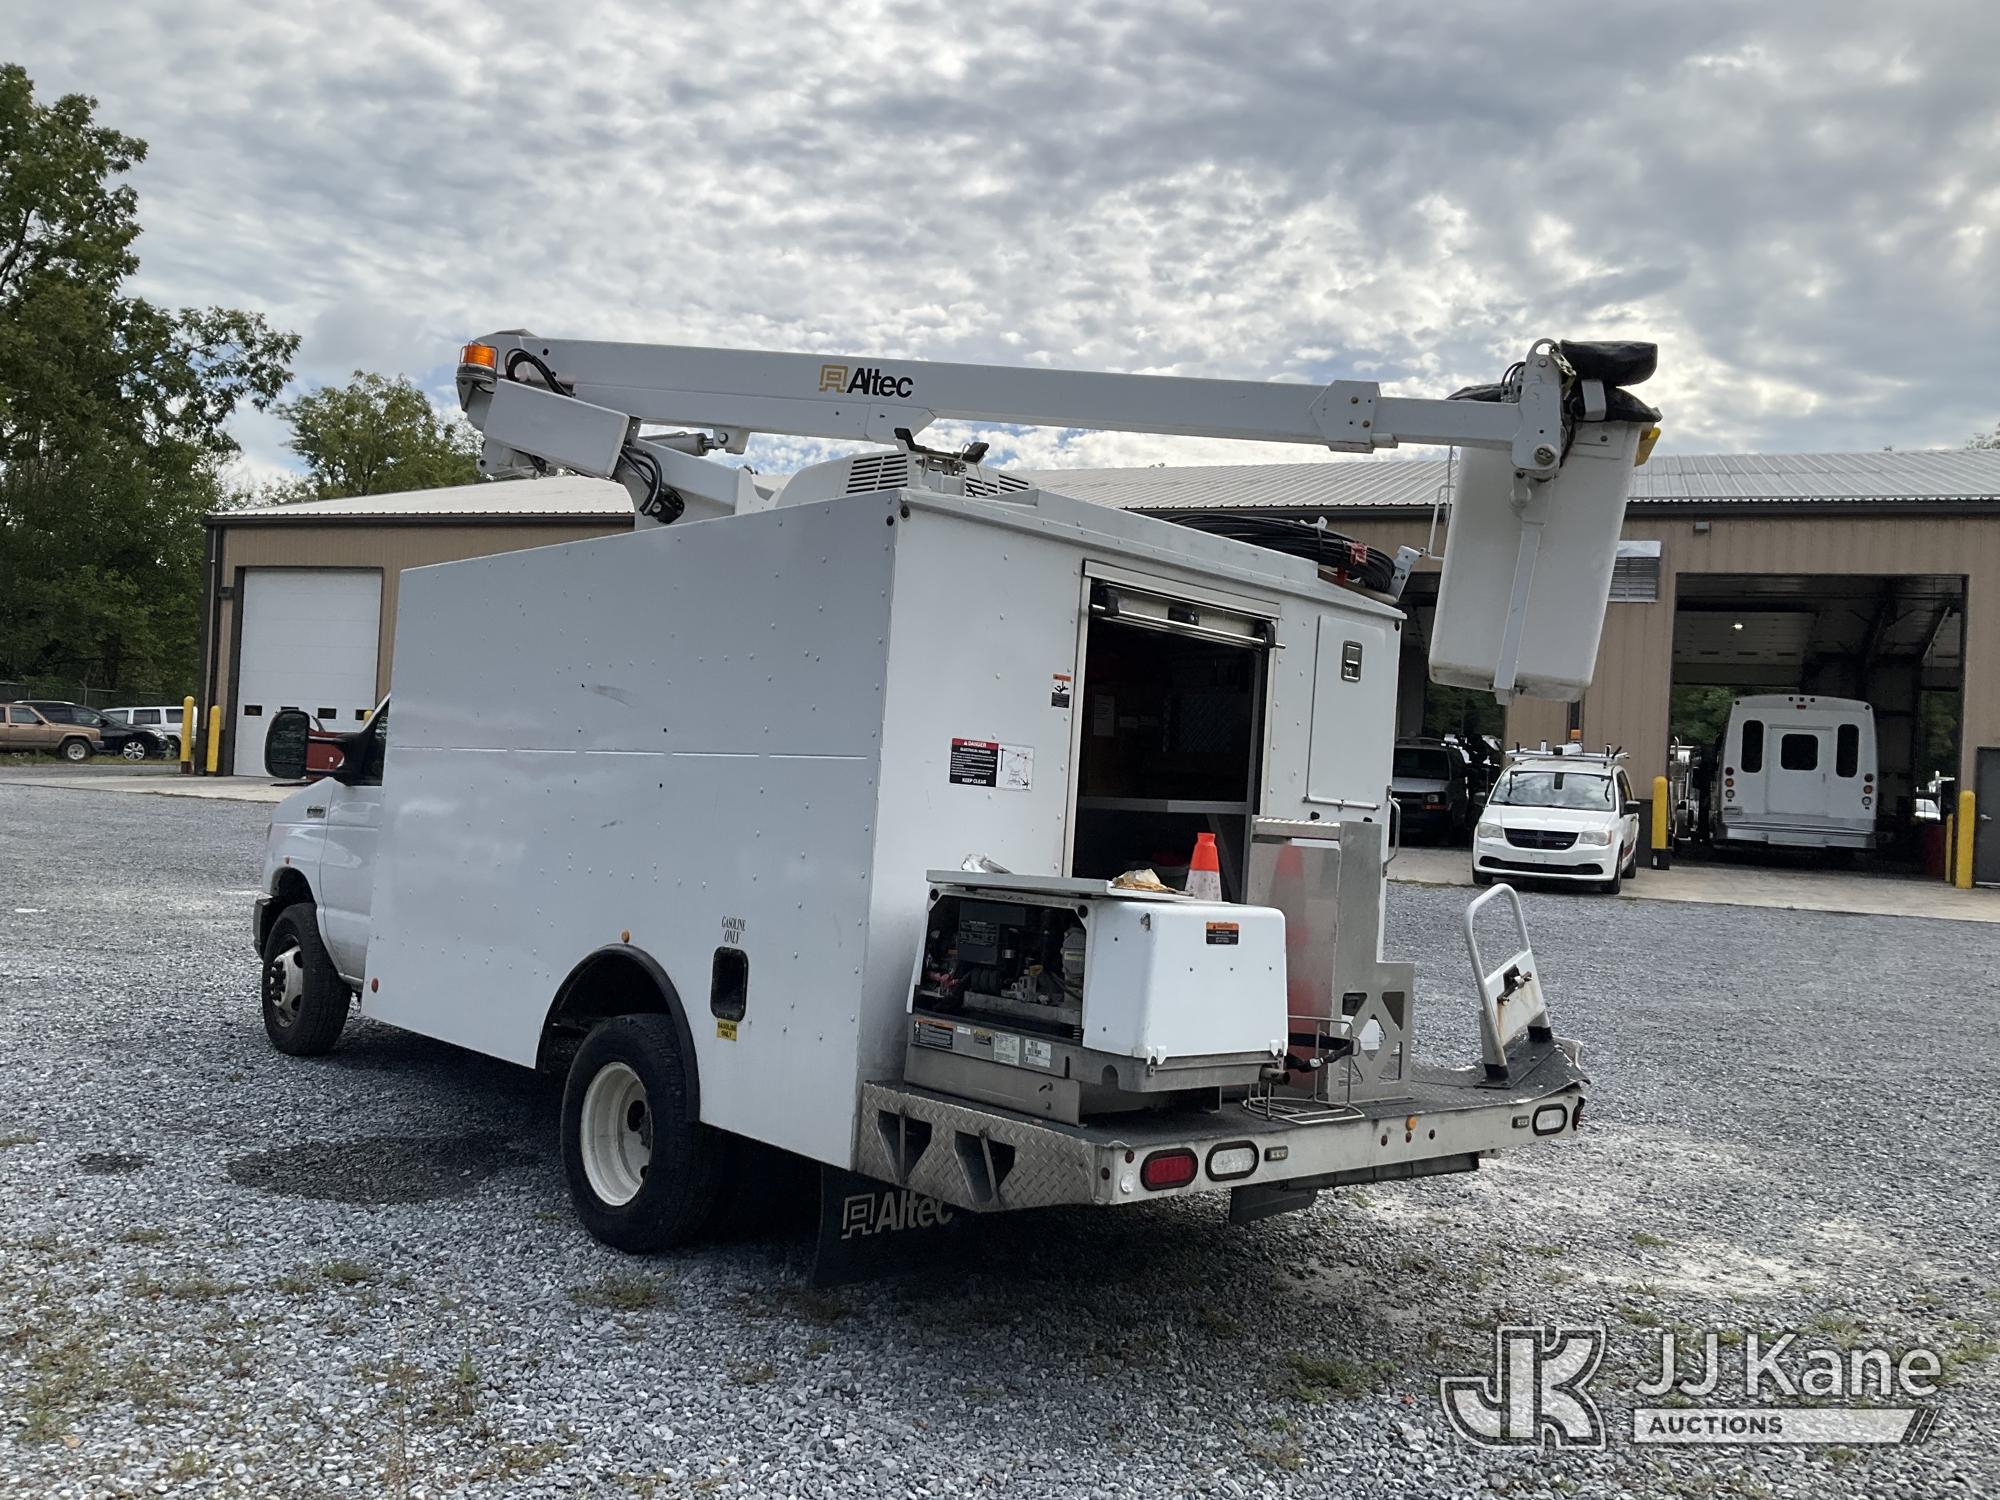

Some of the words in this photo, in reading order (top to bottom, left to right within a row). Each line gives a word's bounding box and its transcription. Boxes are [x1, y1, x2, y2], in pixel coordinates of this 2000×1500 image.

[847, 367, 914, 398] Altec
[721, 915, 746, 931] GASOLINE
[724, 929, 741, 944] ONLY
[874, 1190, 953, 1233] Altec
